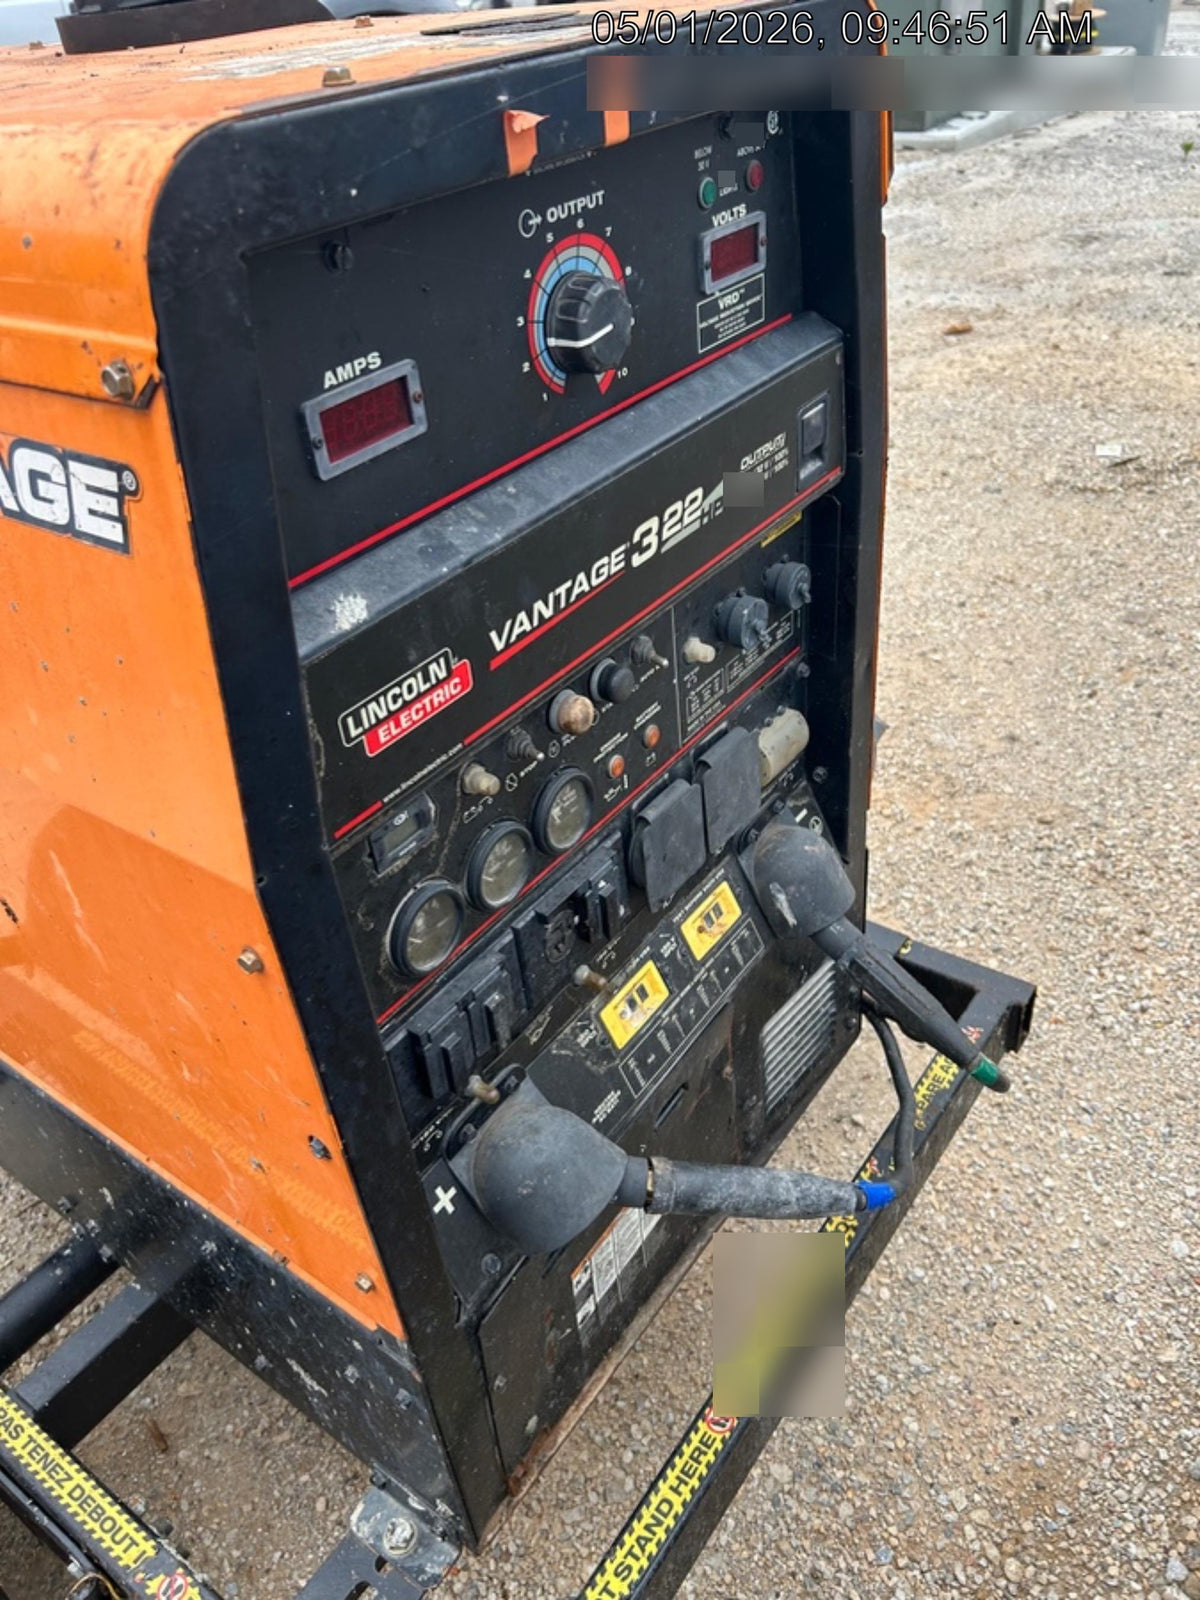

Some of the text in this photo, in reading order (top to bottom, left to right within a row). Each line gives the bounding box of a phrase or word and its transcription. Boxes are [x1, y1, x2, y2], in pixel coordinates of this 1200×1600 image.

[546, 190, 605, 223] OUTPUT
[712, 203, 747, 227] VOLTS
[576, 218, 585, 229] 6
[604, 226, 612, 237] 7
[546, 232, 554, 243] 5
[523, 268, 532, 279] 4
[516, 316, 525, 327] 3
[323, 352, 382, 389] AMPS
[522, 362, 530, 373] 2
[617, 367, 629, 379] 10
[345, 657, 450, 739] LINCOLN
[377, 677, 463, 745] ELECTRIC
[21, 1434, 74, 1489] TENEZ
[67, 1483, 139, 1555] DEBOUT
[614, 1497, 675, 1583] STAND
[669, 1431, 717, 1497] HERE
